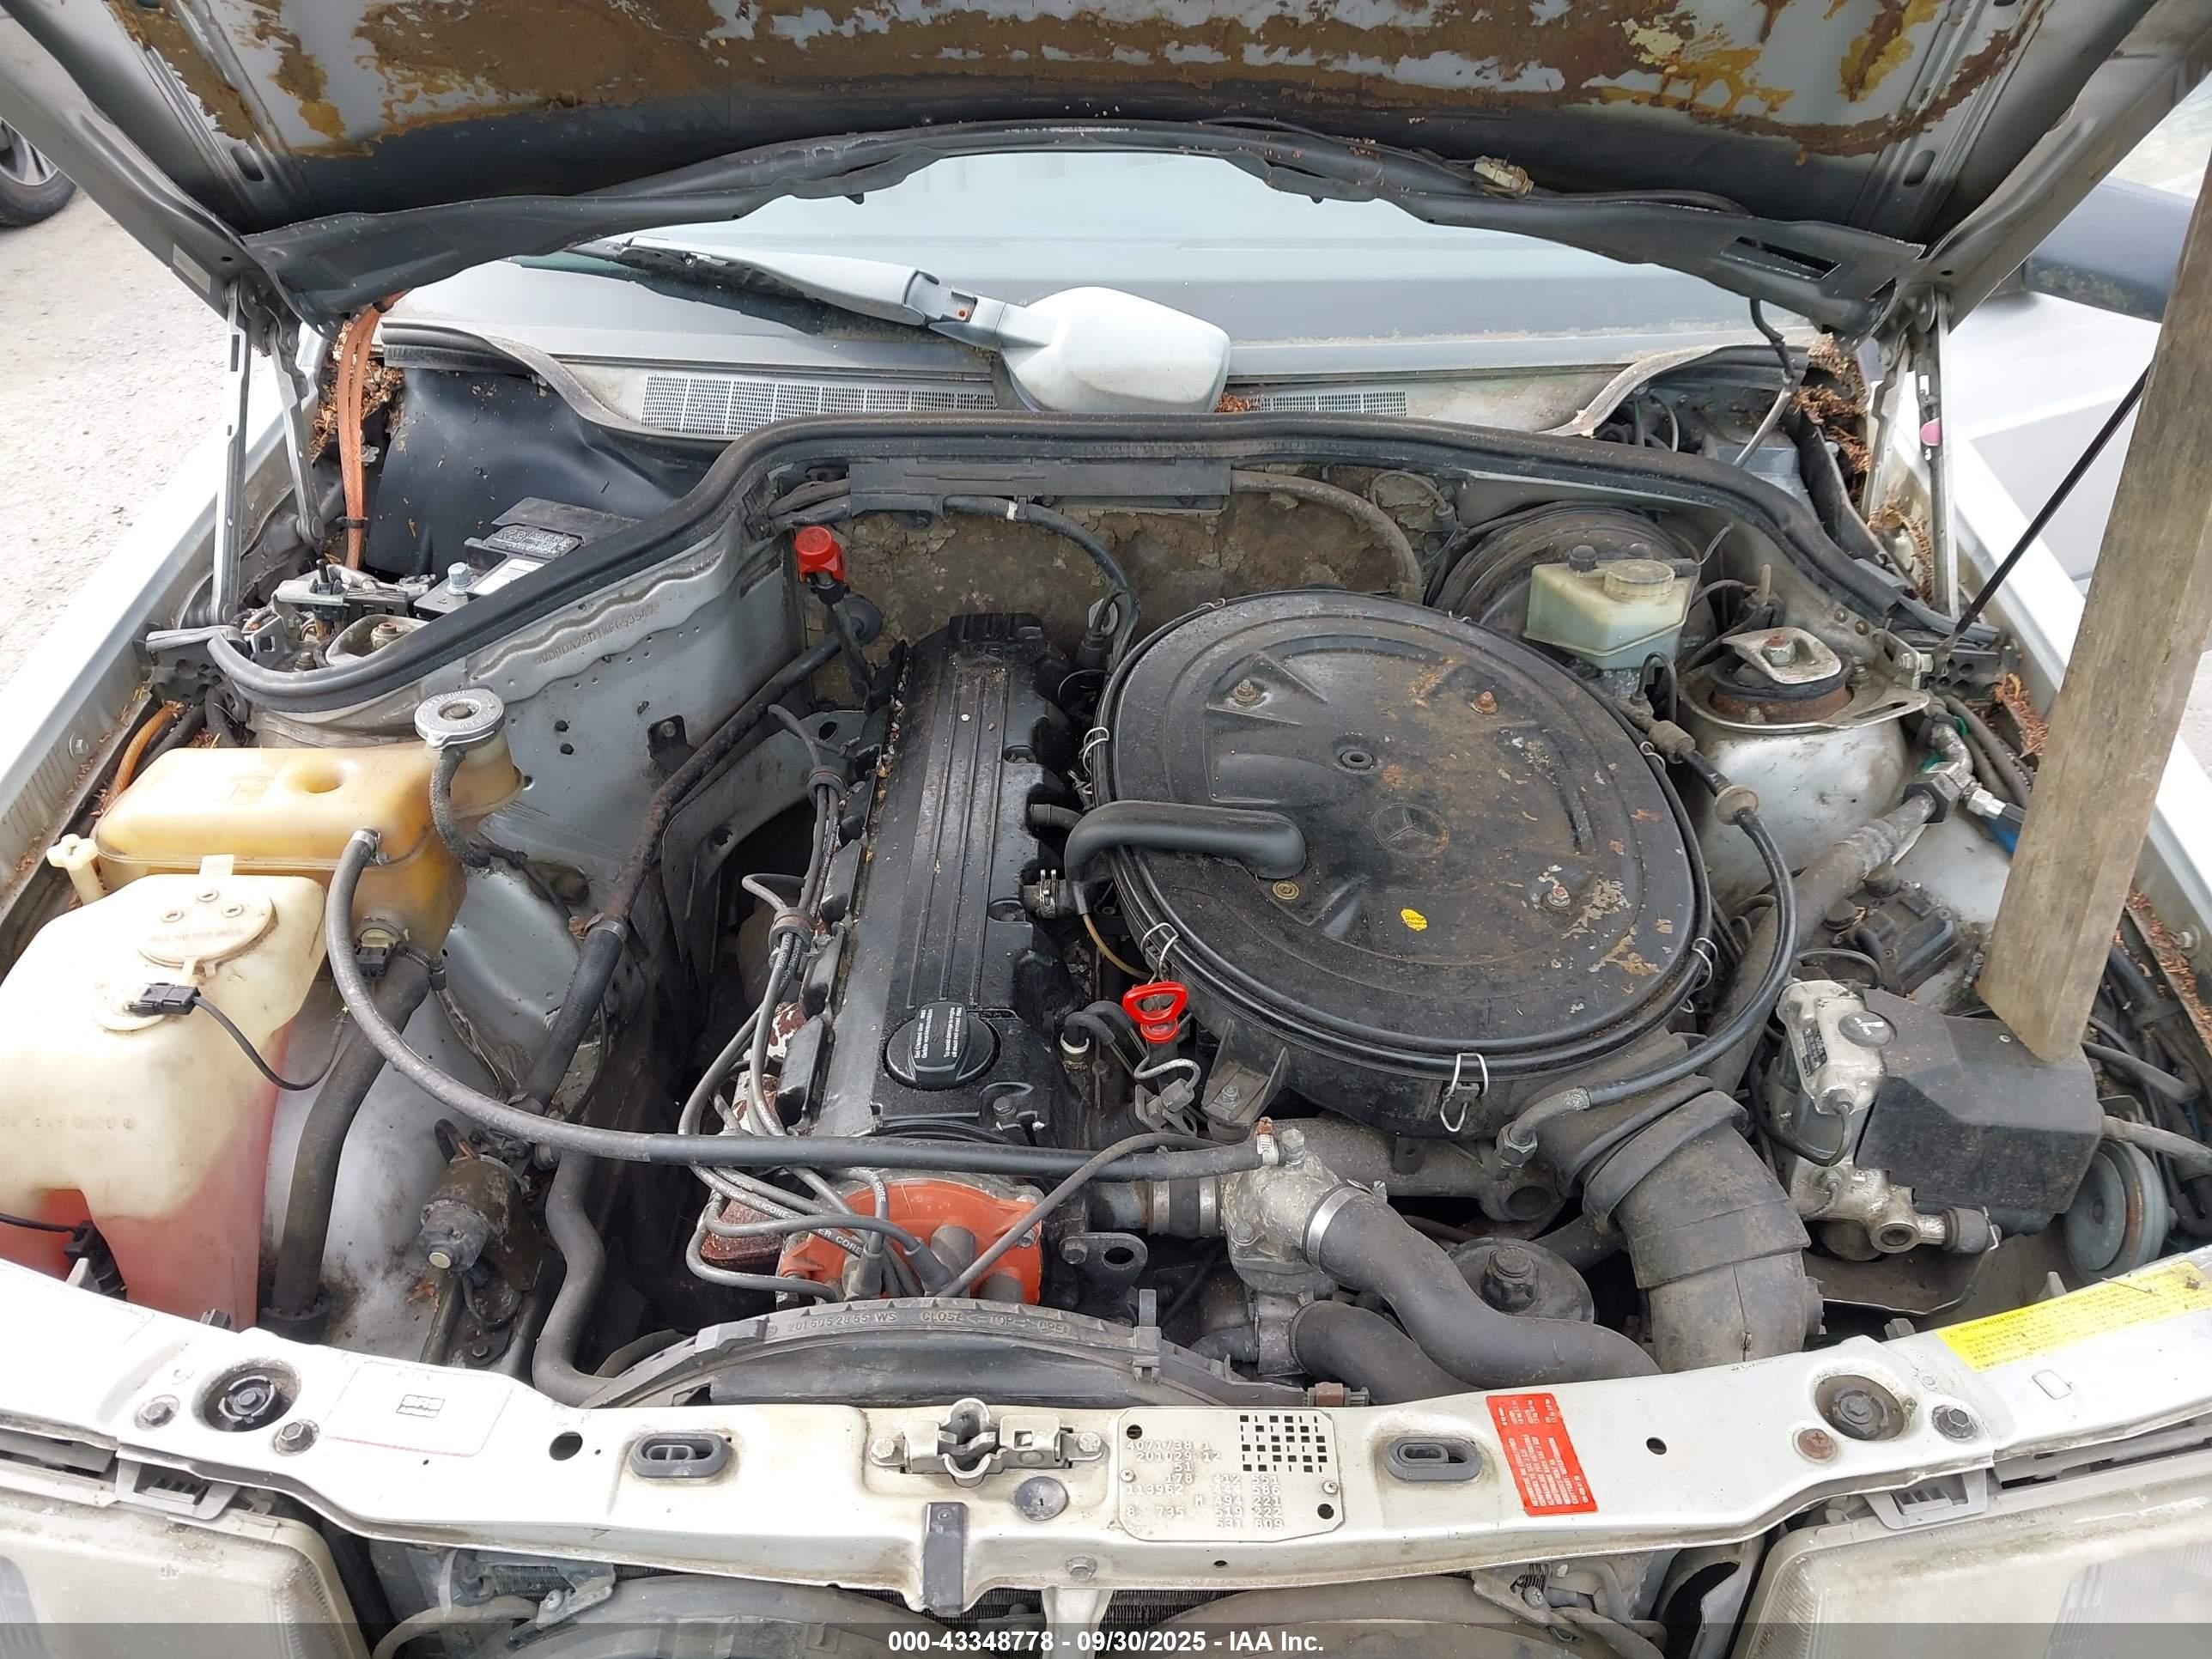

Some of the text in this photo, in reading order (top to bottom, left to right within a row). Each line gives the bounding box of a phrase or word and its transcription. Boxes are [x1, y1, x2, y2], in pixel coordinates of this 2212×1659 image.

[836, 1236, 864, 1256] CORE
[874, 1311, 898, 1322] WS
[921, 1310, 963, 1323] CLOSE
[1127, 1440, 1210, 1451] 4071738 1
[1136, 1451, 1221, 1462] 201029 12
[1174, 1462, 1193, 1473] 51
[1165, 1473, 1194, 1484] 178
[1127, 1484, 1183, 1495] 113962
[1253, 1484, 1281, 1495] 586
[1214, 1495, 1243, 1506] 494
[1253, 1495, 1281, 1506] 221
[1126, 1506, 1135, 1517] 8
[1155, 1505, 1185, 1517] 735
[1254, 1506, 1283, 1517] 222
[1255, 1518, 1284, 1530] 809
